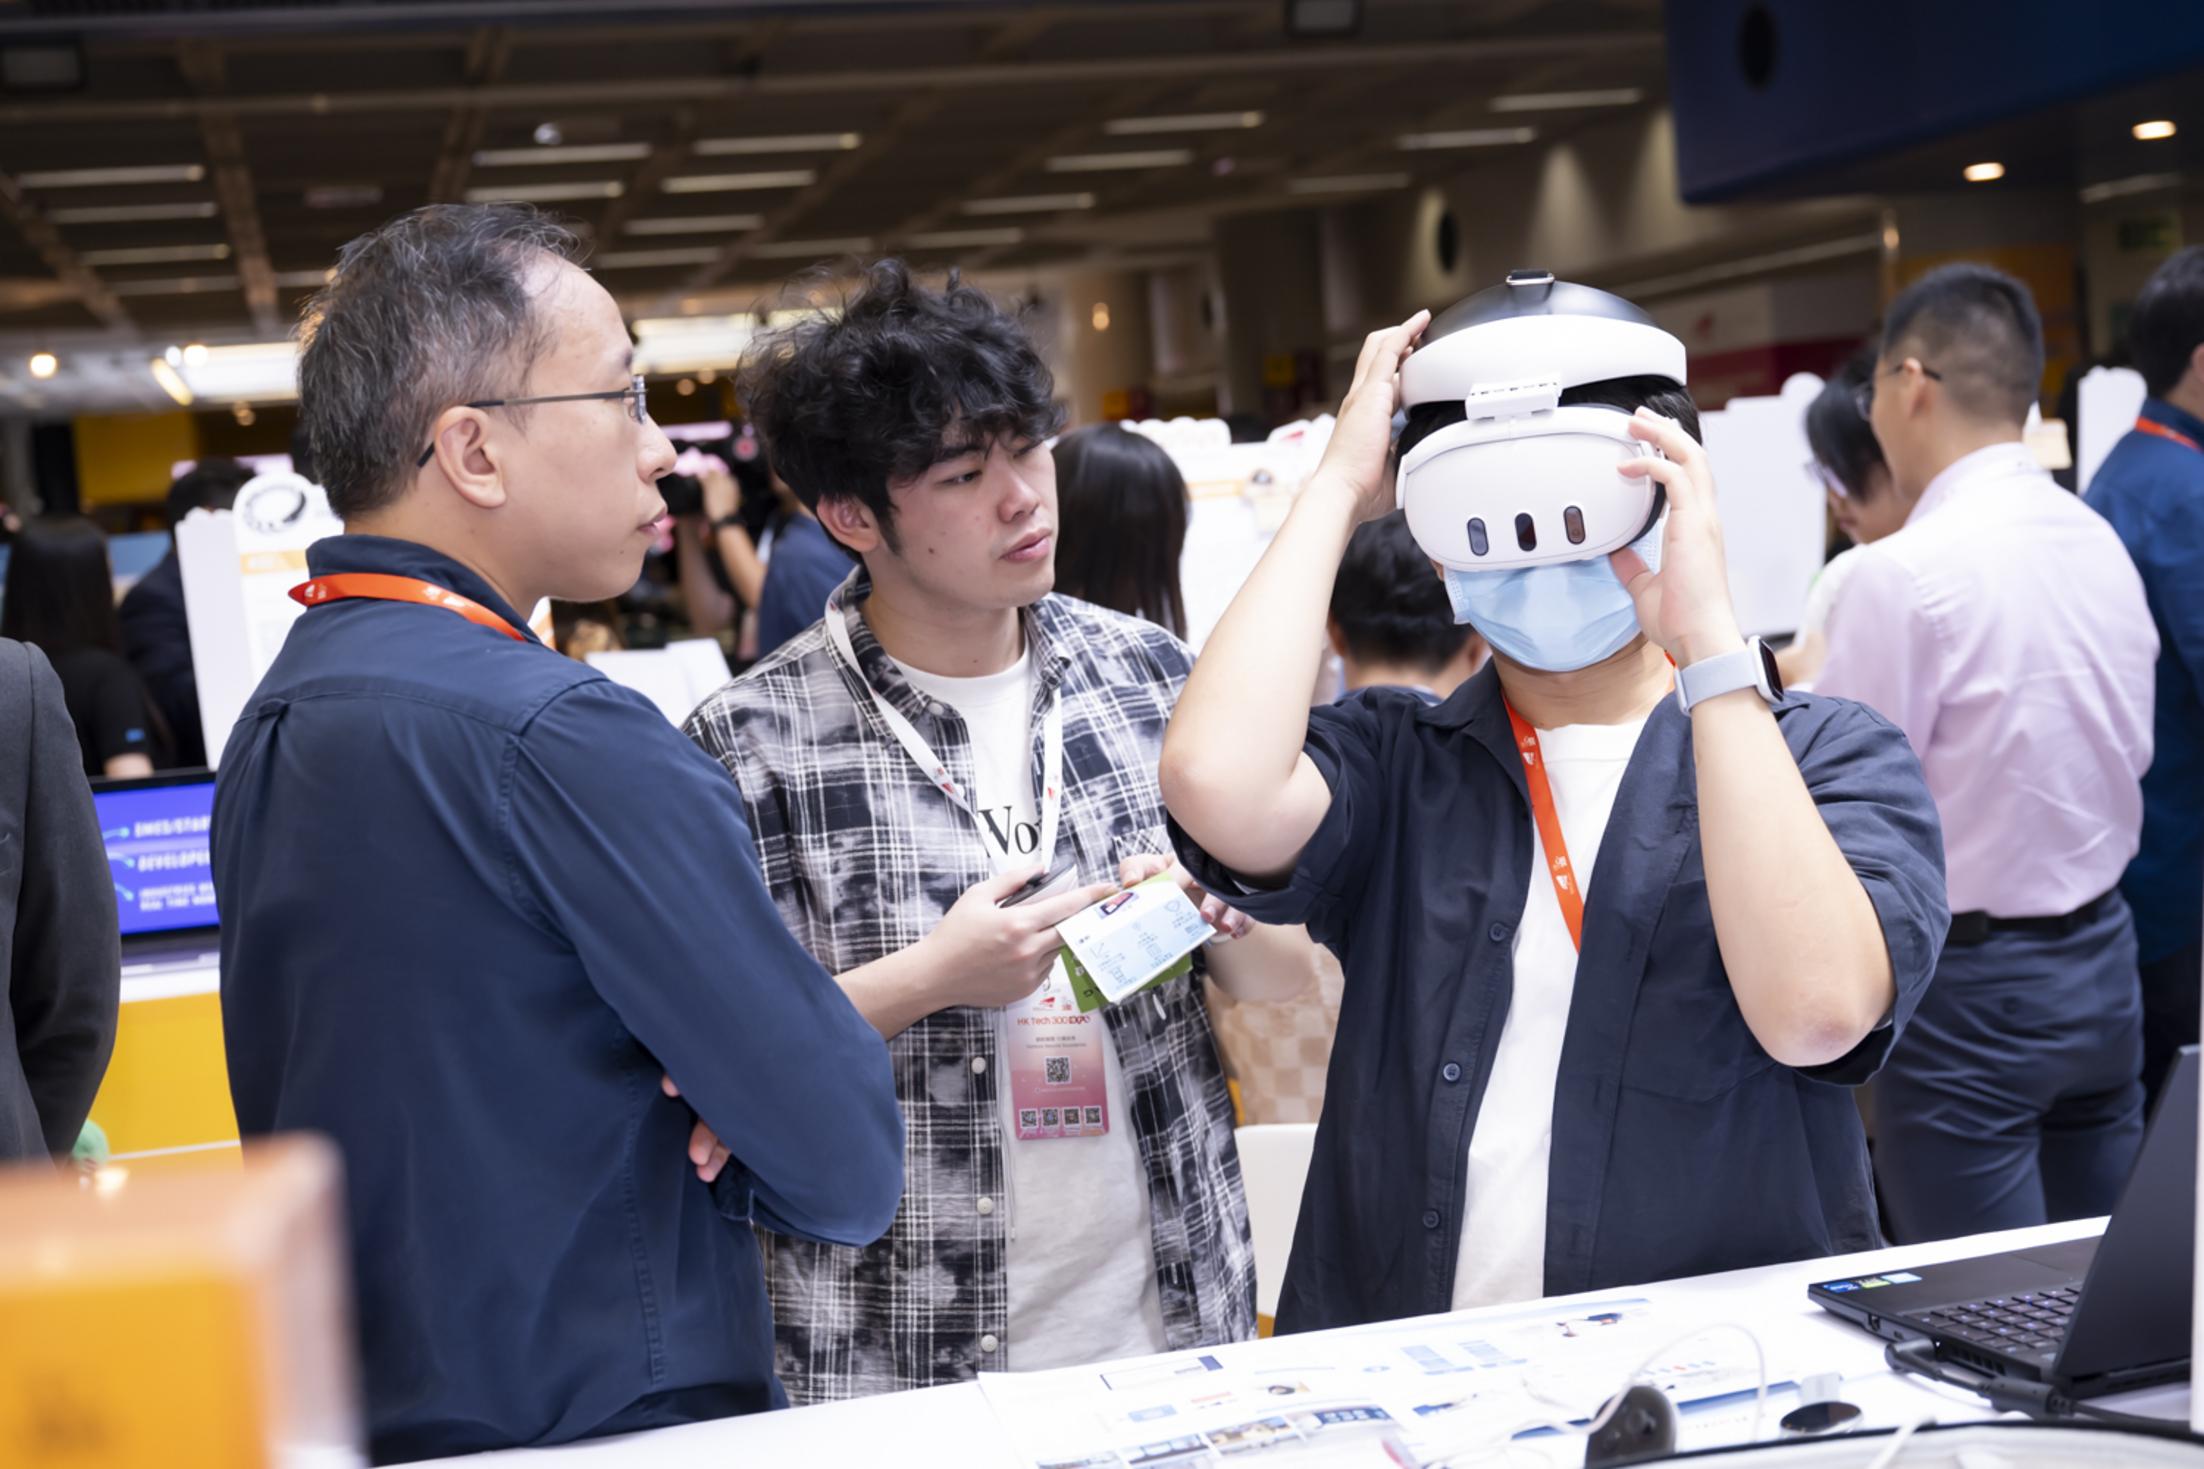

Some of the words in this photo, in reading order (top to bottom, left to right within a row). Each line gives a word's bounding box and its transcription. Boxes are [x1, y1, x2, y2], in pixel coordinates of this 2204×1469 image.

[977, 805, 1041, 856] Vo
[1017, 1017, 1029, 1025] HK
[1031, 1016, 1051, 1025] Tech
